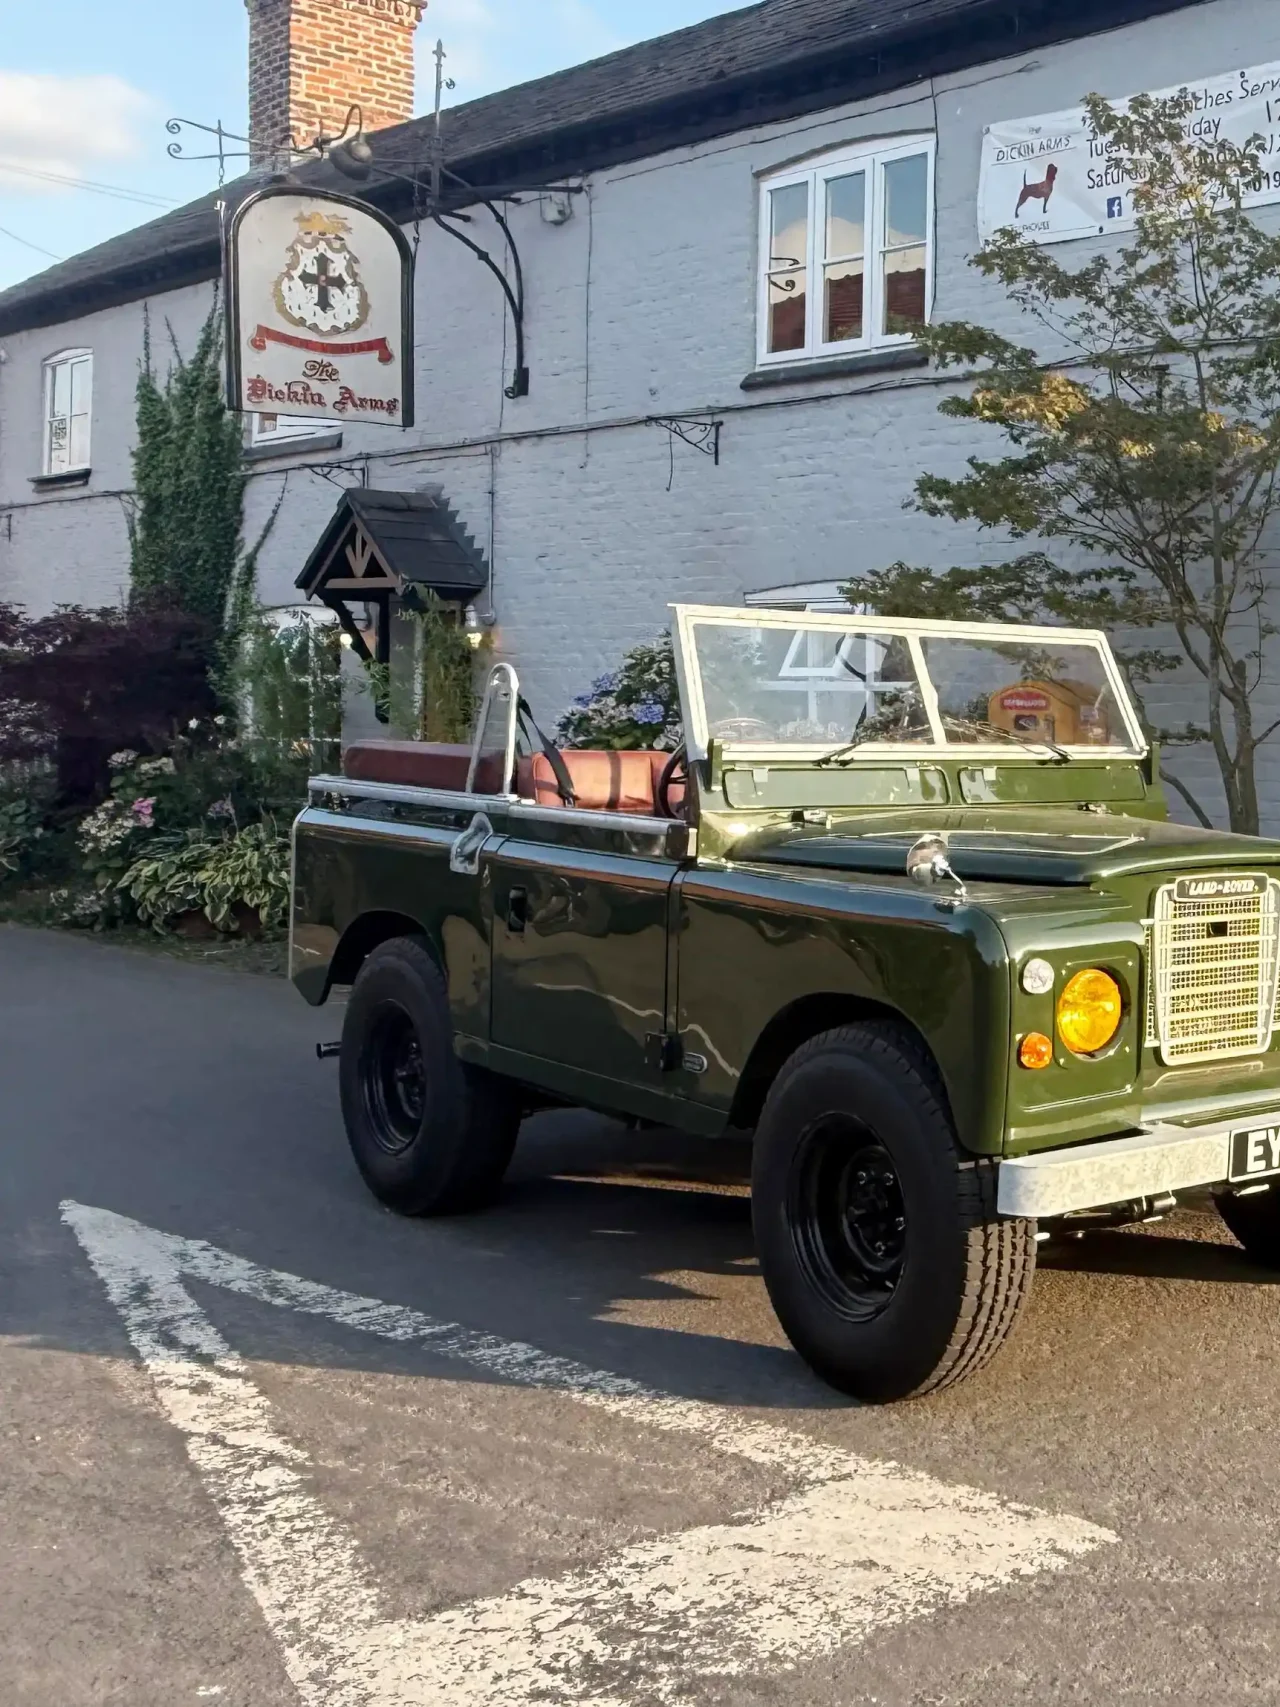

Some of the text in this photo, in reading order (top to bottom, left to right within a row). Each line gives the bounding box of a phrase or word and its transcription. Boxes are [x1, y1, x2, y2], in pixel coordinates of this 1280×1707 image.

[996, 136, 1072, 162] DICKIN ARMS
[301, 358, 340, 382] The
[247, 374, 400, 415] Dickin Arms
